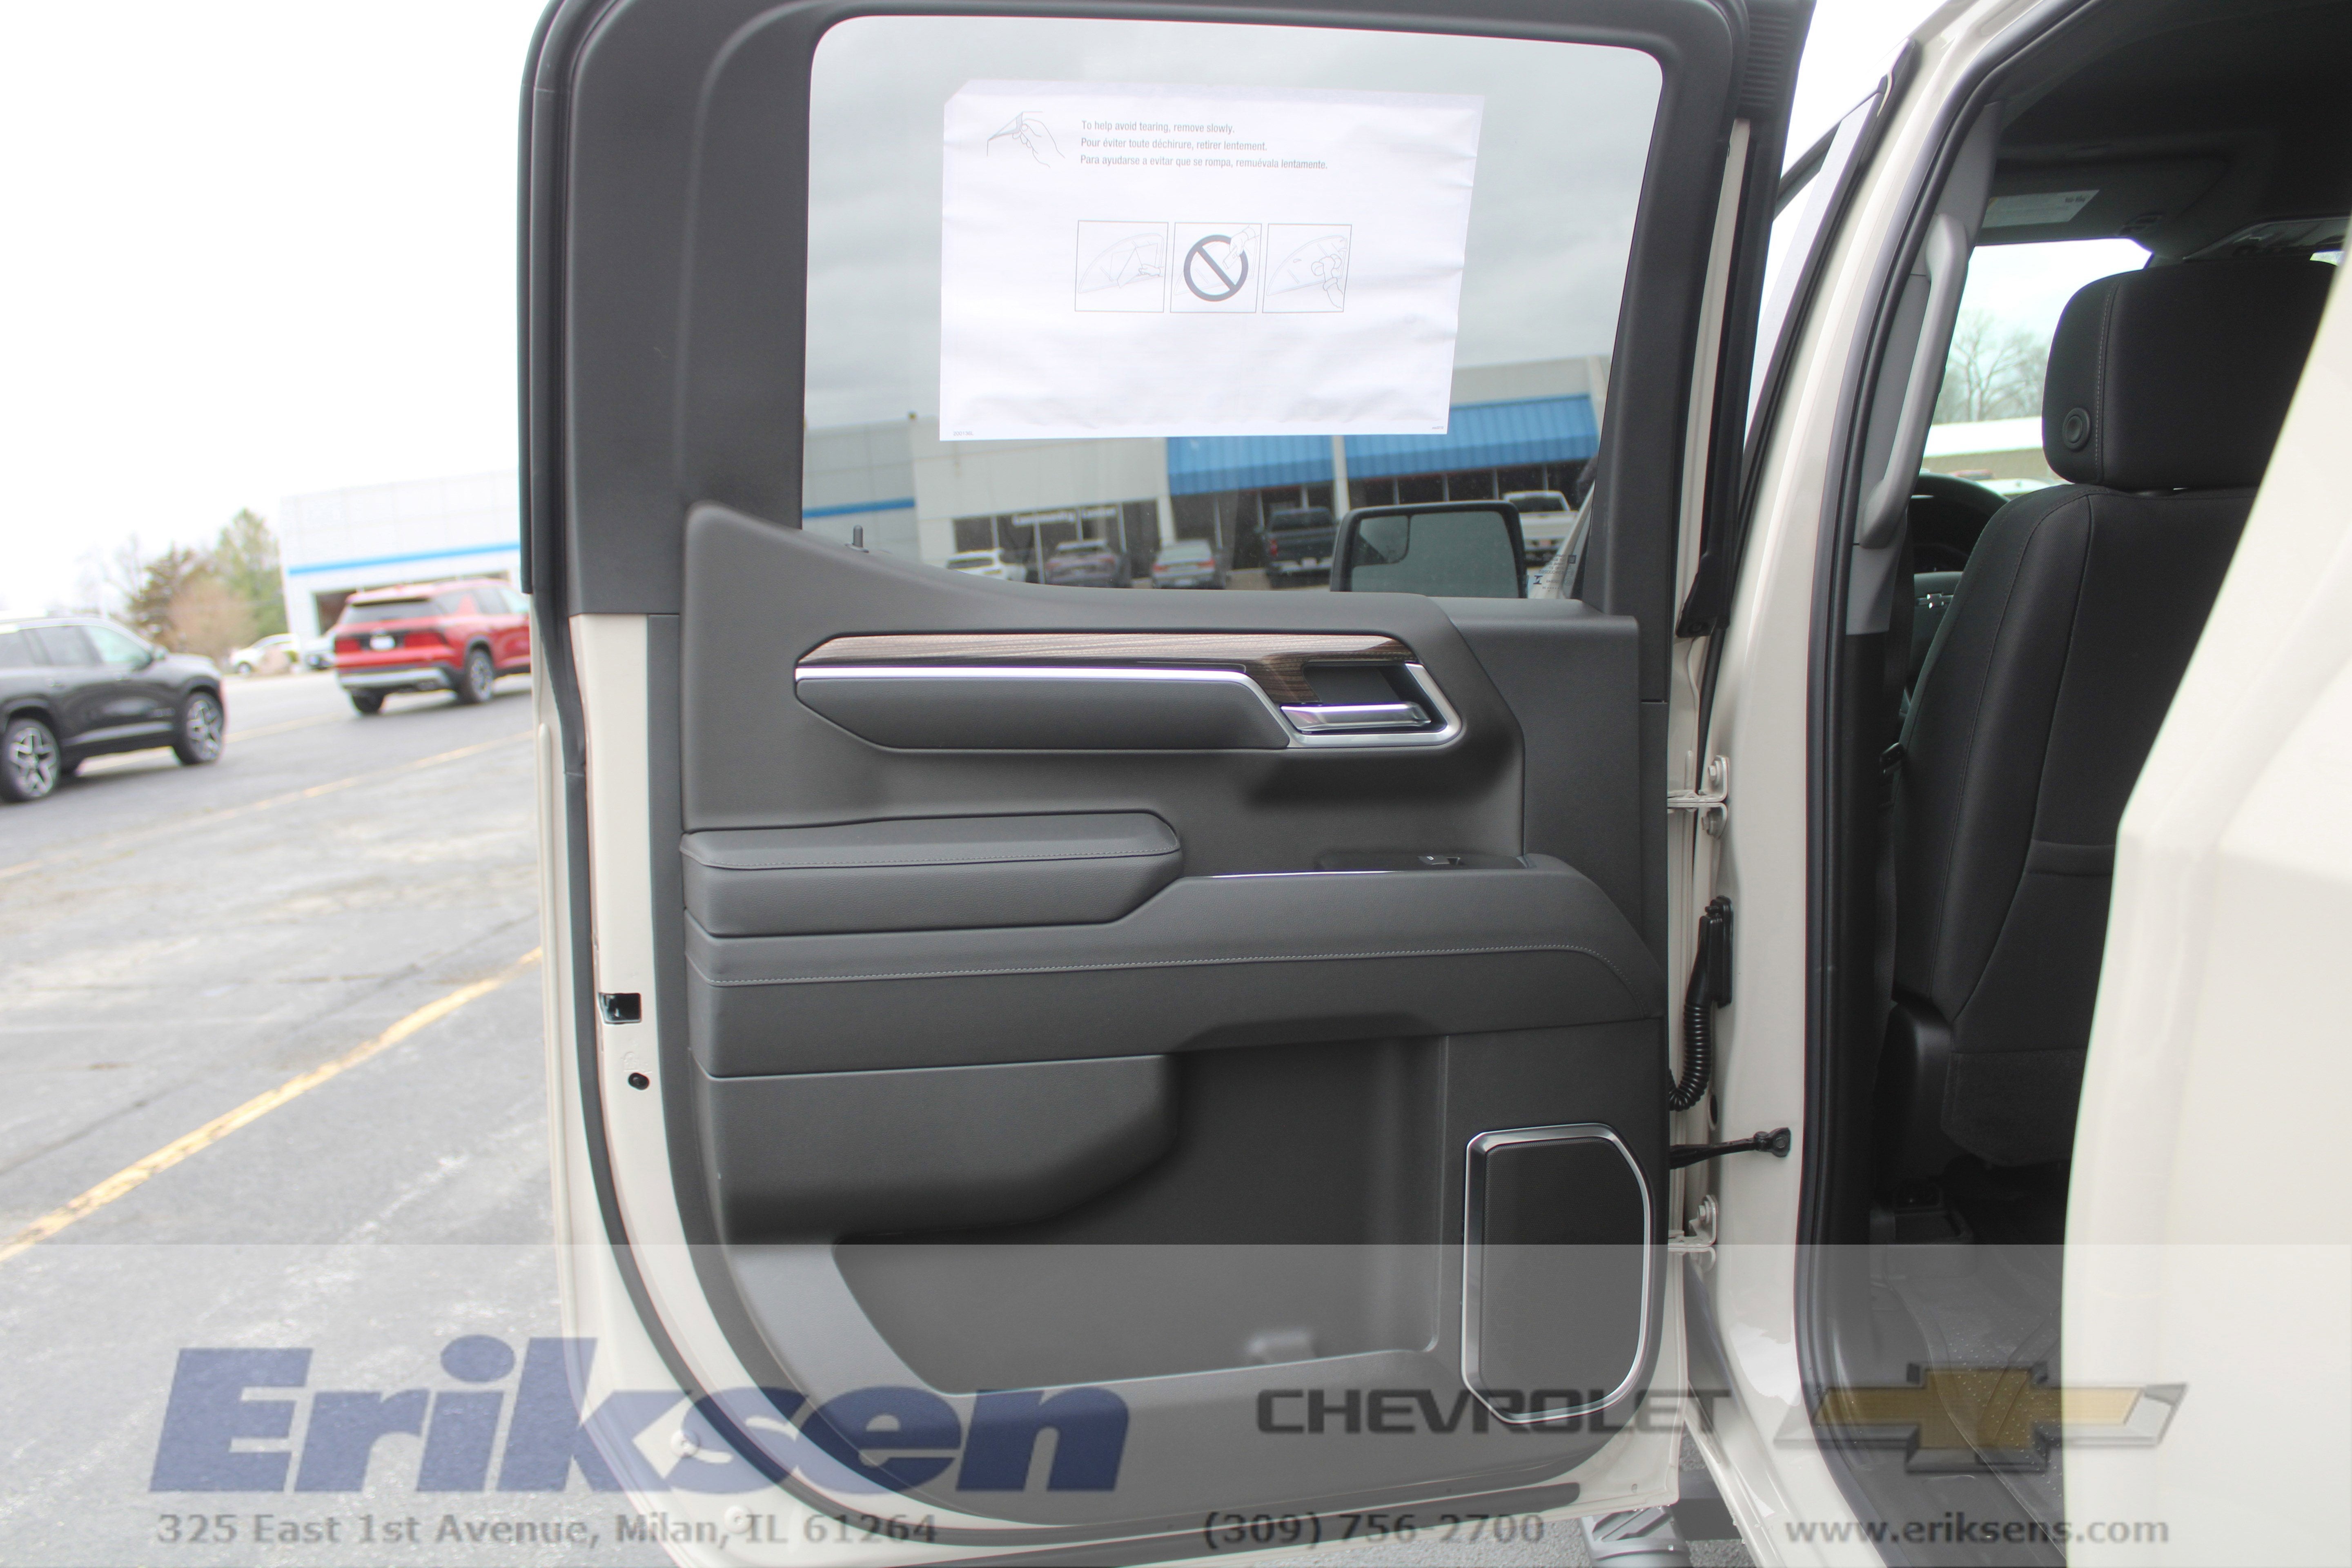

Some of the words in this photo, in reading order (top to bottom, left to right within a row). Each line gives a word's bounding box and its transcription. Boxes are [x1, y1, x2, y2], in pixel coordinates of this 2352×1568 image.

[1082, 120, 1091, 130] To
[1095, 121, 1112, 132] help
[1115, 121, 1137, 131] avoid
[1140, 122, 1171, 133] tearing,
[1174, 124, 1204, 132] remove
[1207, 123, 1234, 135] slowly.
[1081, 138, 1100, 147] Pour
[1103, 138, 1126, 148] éviter
[1129, 139, 1149, 148] toute
[1152, 138, 1194, 151] déchirure,
[1197, 140, 1221, 149] retirer
[1224, 141, 1267, 151] lentement.
[1081, 154, 1099, 164] Para
[1102, 156, 1140, 166] ayudarse
[1150, 156, 1173, 165] evitar
[1176, 158, 1190, 167] que
[1205, 159, 1233, 168] rompa,
[1236, 158, 1278, 168] remuévala
[1281, 159, 1327, 169] lentamente.
